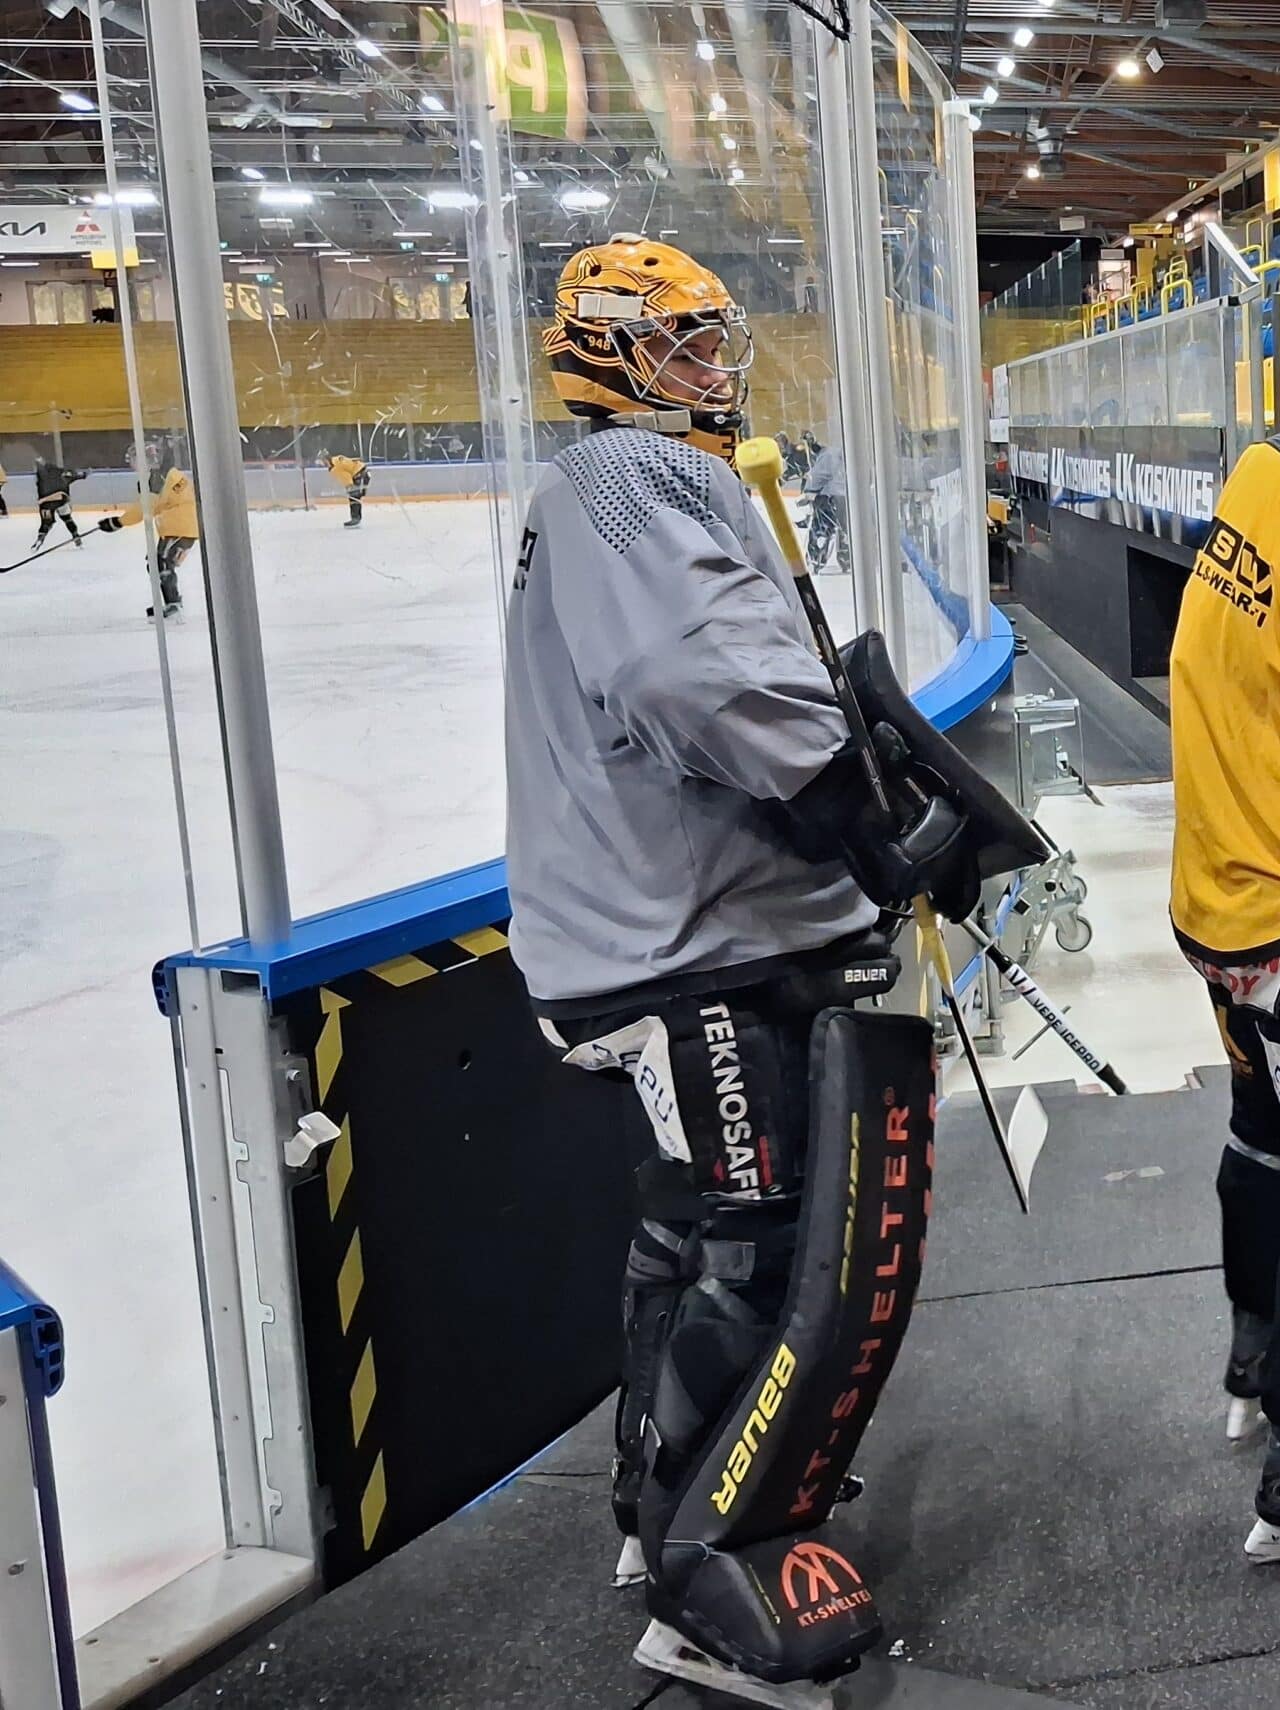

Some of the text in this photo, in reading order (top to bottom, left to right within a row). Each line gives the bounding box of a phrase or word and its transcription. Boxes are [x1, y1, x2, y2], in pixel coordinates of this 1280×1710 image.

[1135, 463, 1214, 522] KOSKIMIES
[844, 967, 888, 983] BAUER
[710, 1342, 797, 1515] BAUER
